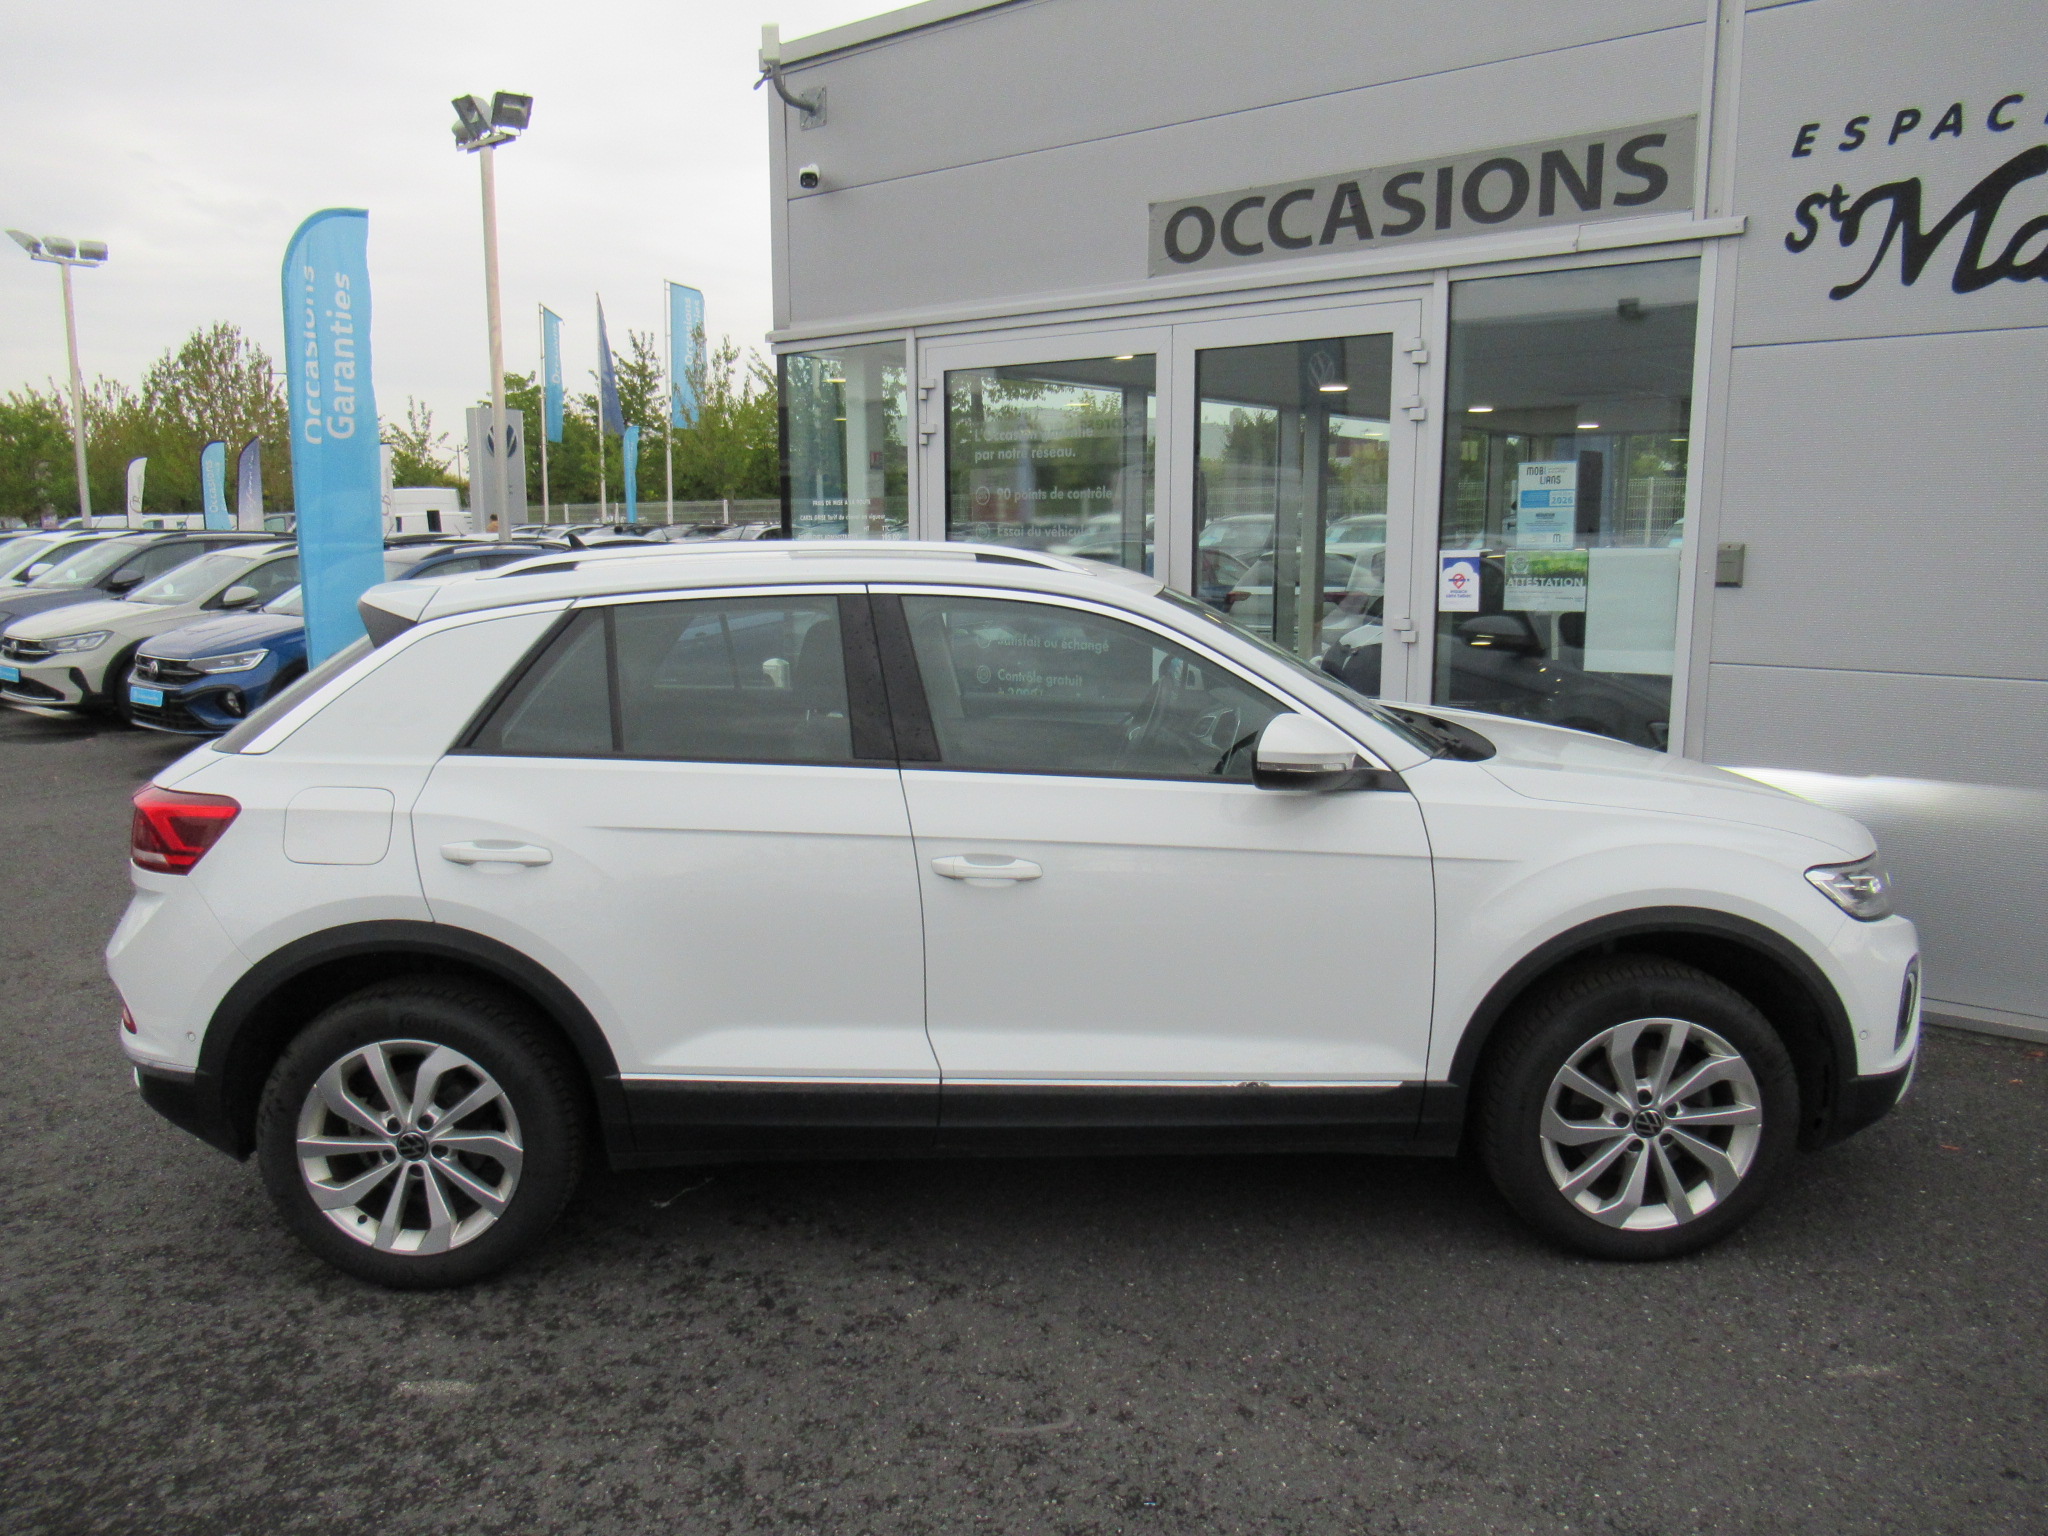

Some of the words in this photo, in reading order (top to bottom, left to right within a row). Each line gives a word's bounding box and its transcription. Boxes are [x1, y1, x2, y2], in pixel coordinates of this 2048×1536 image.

[1790, 92, 2048, 158] ESPAC
[1163, 132, 1671, 266] OCCASIONS
[325, 271, 357, 440] Garanties
[975, 450, 994, 464] par
[997, 446, 1028, 460] notre
[1031, 446, 1077, 459] réseau.
[206, 460, 217, 513] Occasions
[996, 488, 1011, 500] 90
[1014, 487, 1047, 503] points
[1052, 486, 1064, 500] de
[1067, 485, 1113, 500] contrôle
[997, 525, 1024, 537] Essai
[1027, 525, 1042, 537] du
[1506, 577, 1584, 588] ATTESTATION
[1043, 639, 1057, 649] ou
[1061, 638, 1110, 654] échangé
[997, 668, 1043, 684] Contrôle
[1046, 673, 1083, 688] gratuit
